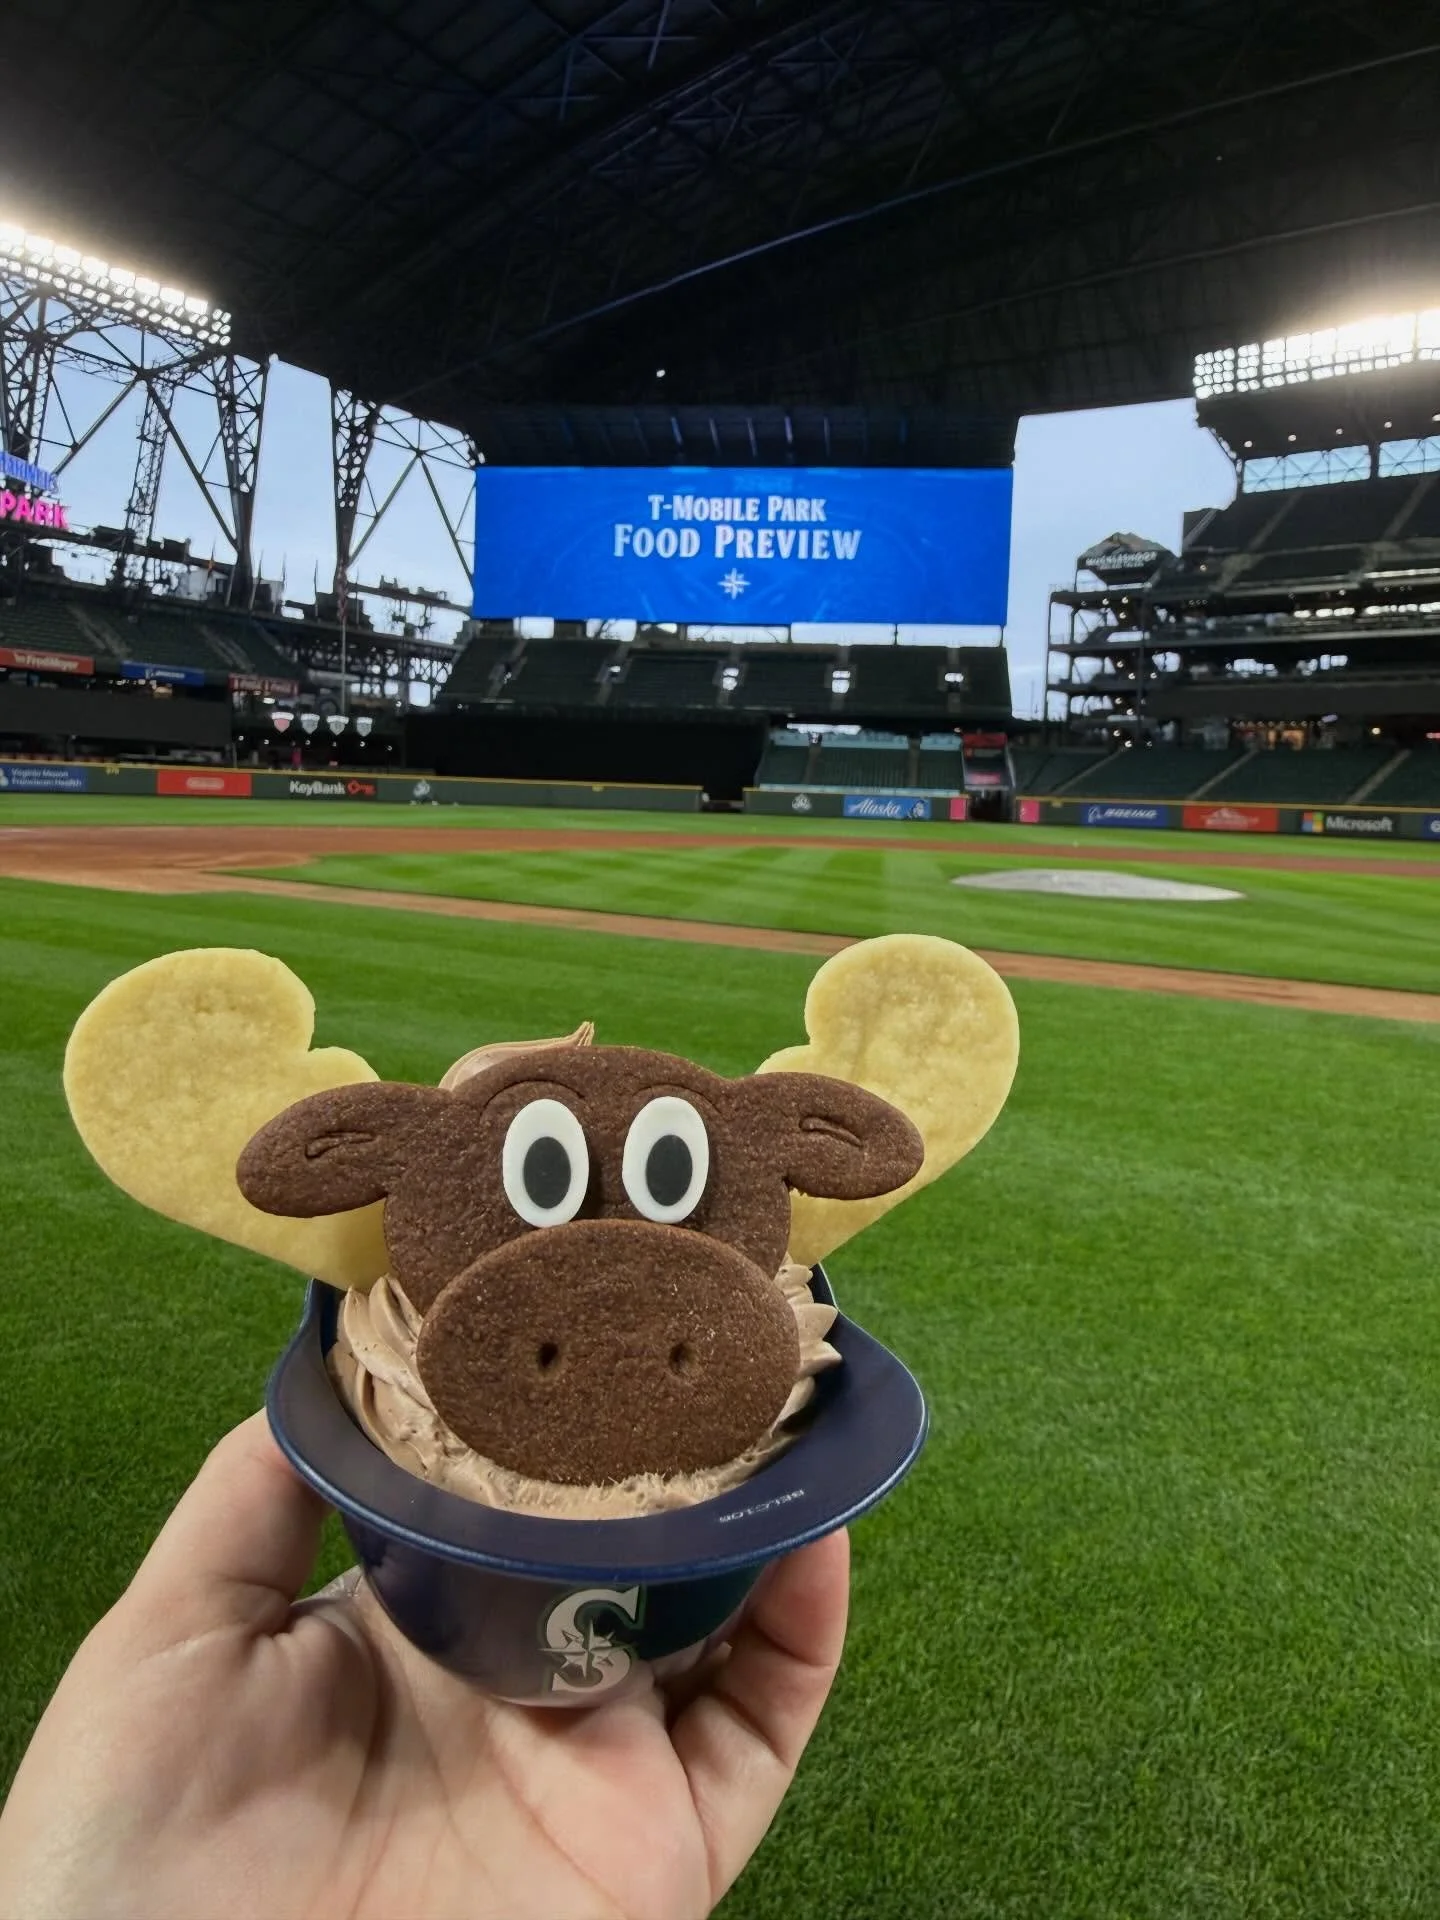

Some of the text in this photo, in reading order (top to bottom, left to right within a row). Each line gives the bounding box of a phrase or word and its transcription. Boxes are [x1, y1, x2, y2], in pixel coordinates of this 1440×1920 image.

[648, 494, 827, 522] T-MOBILE PARK
[613, 523, 862, 560] FOOD PREVIEW
[289, 780, 345, 796] KeyBank
[848, 798, 901, 817] Alaska
[1326, 815, 1392, 832] Microsoft
